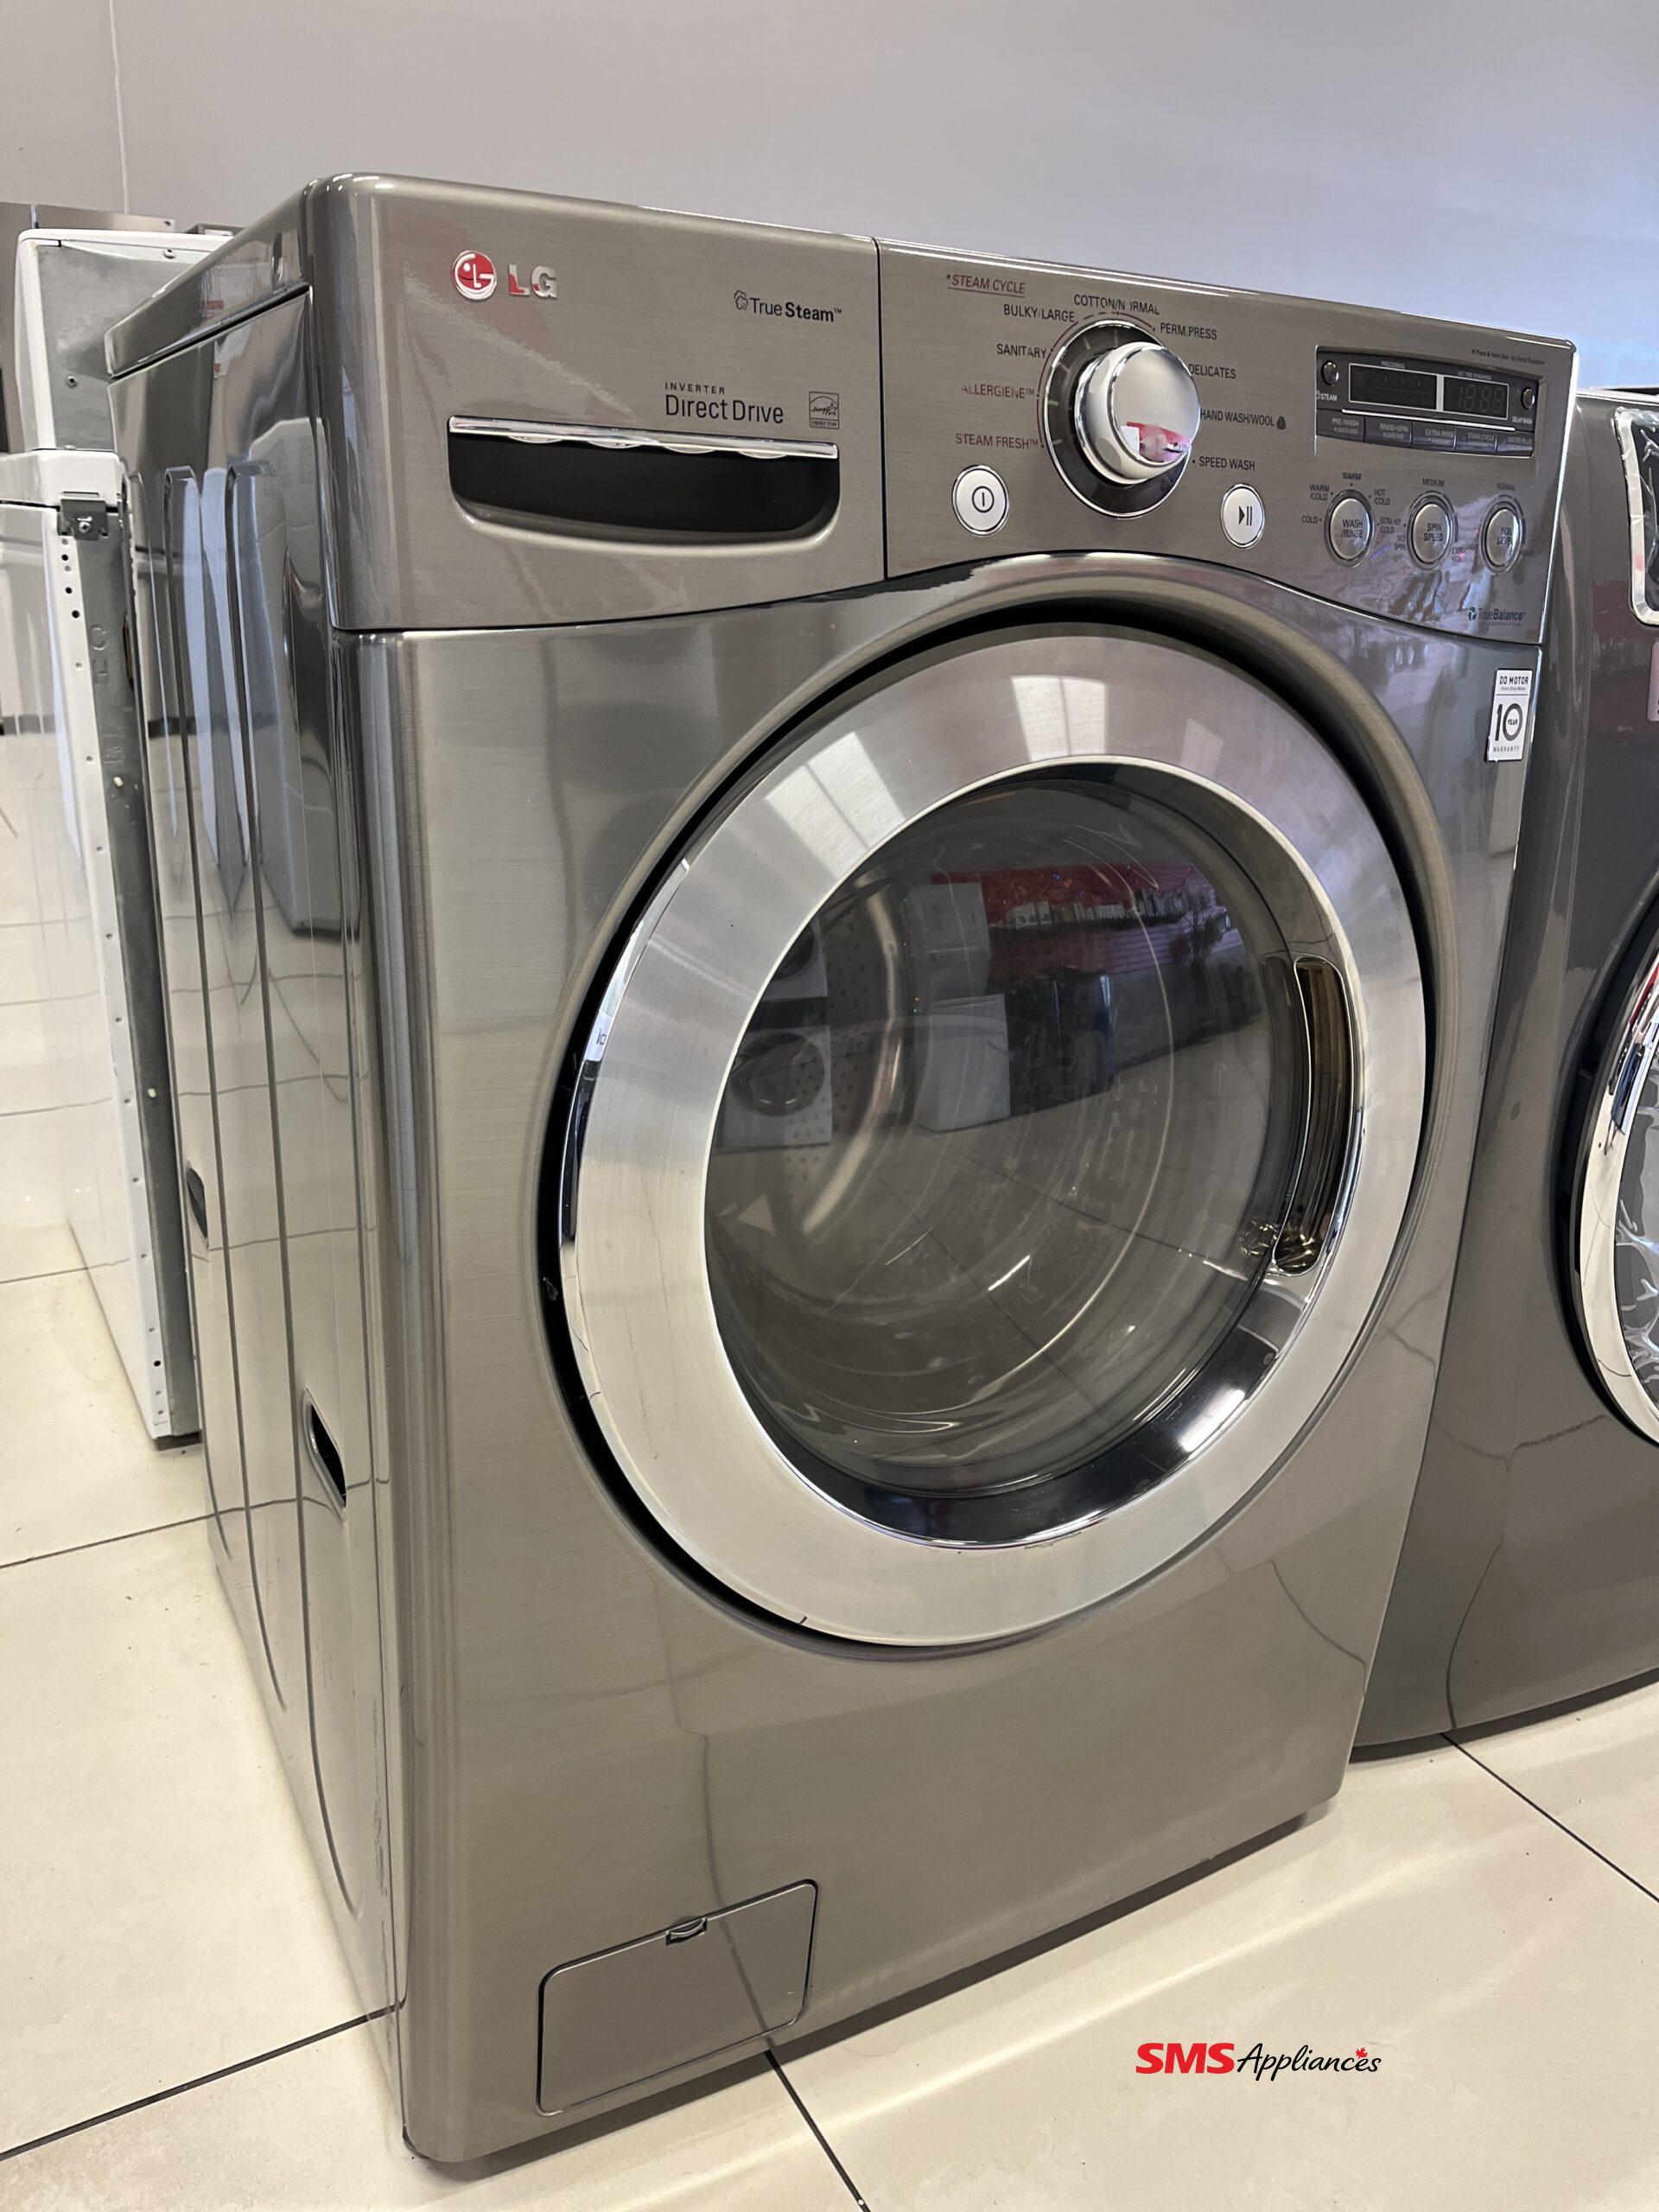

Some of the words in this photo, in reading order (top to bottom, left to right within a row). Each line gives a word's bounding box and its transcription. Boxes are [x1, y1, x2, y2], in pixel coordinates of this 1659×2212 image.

[508, 264, 558, 299] LG
[993, 279, 1027, 295] CYCLE
[996, 343, 1047, 359] SANITARY
[1188, 363, 1237, 379] DELICATES
[664, 382, 726, 395] INVERTER
[1320, 391, 1338, 402] STEAM
[665, 394, 728, 421] Direct
[732, 399, 785, 424] Drive
[1200, 409, 1224, 422] HAND
[955, 433, 993, 447] STEAM
[1198, 455, 1228, 469] SPEED
[1229, 458, 1255, 471] WASH
[1342, 472, 1362, 481] WARM
[1421, 478, 1445, 487] MEDIUM
[1309, 483, 1330, 493] WARM
[1374, 488, 1386, 497] HOT
[1301, 515, 1319, 524] COLD
[1342, 519, 1363, 529] WASH
[1427, 523, 1442, 532] SPIN
[1423, 532, 1444, 543] SPEED
[1499, 676, 1508, 685] DD
[1510, 676, 1529, 685] MOTOR
[1495, 702, 1523, 741] 10
